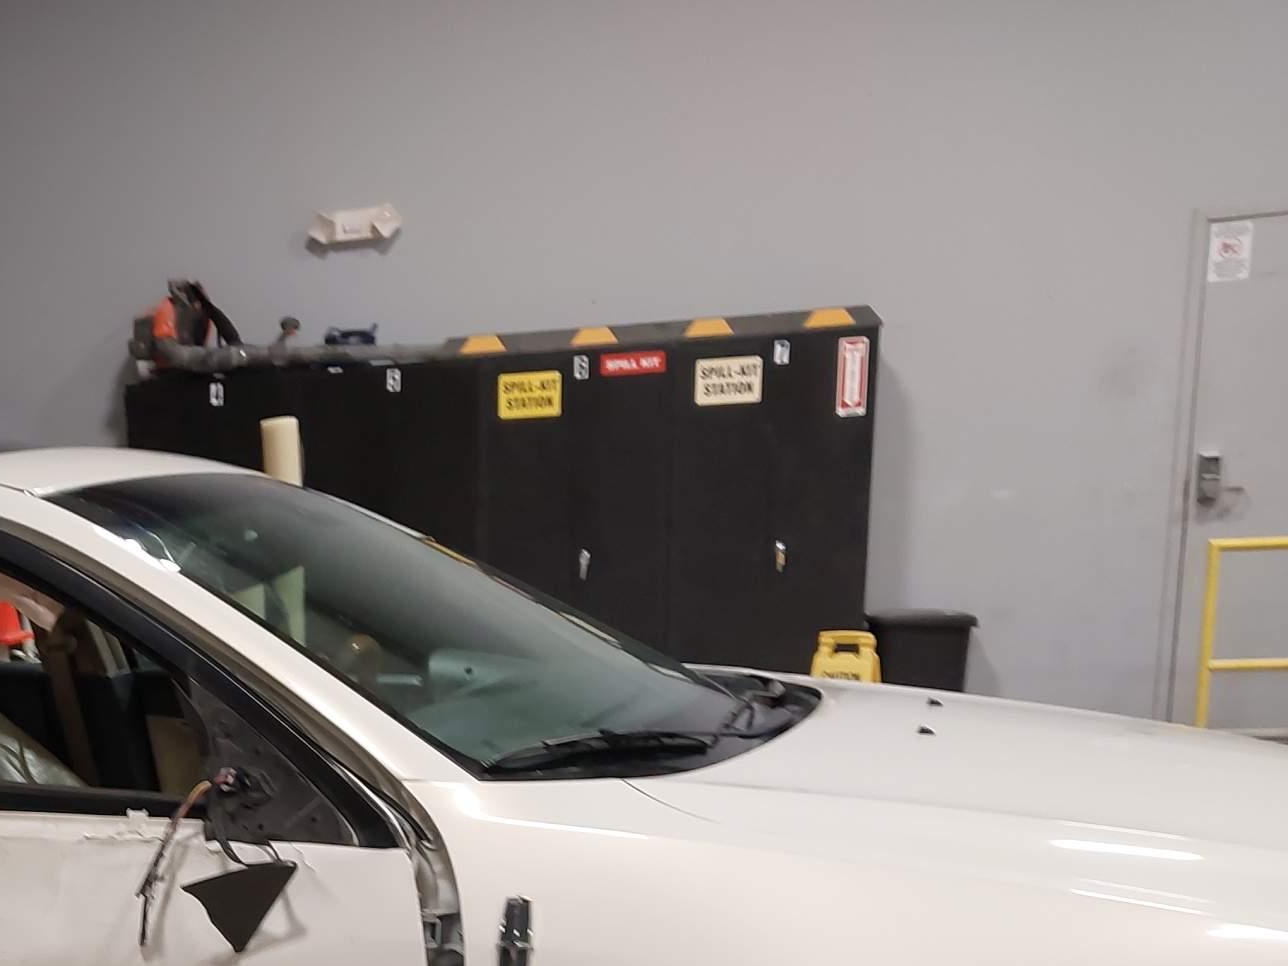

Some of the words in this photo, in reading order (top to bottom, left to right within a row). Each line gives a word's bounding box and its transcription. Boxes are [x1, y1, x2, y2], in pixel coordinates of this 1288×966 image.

[700, 364, 758, 380] SPILL-KIT
[503, 379, 557, 394] SPILL-KIT
[704, 381, 754, 397] STATION
[506, 395, 554, 410] STATION
